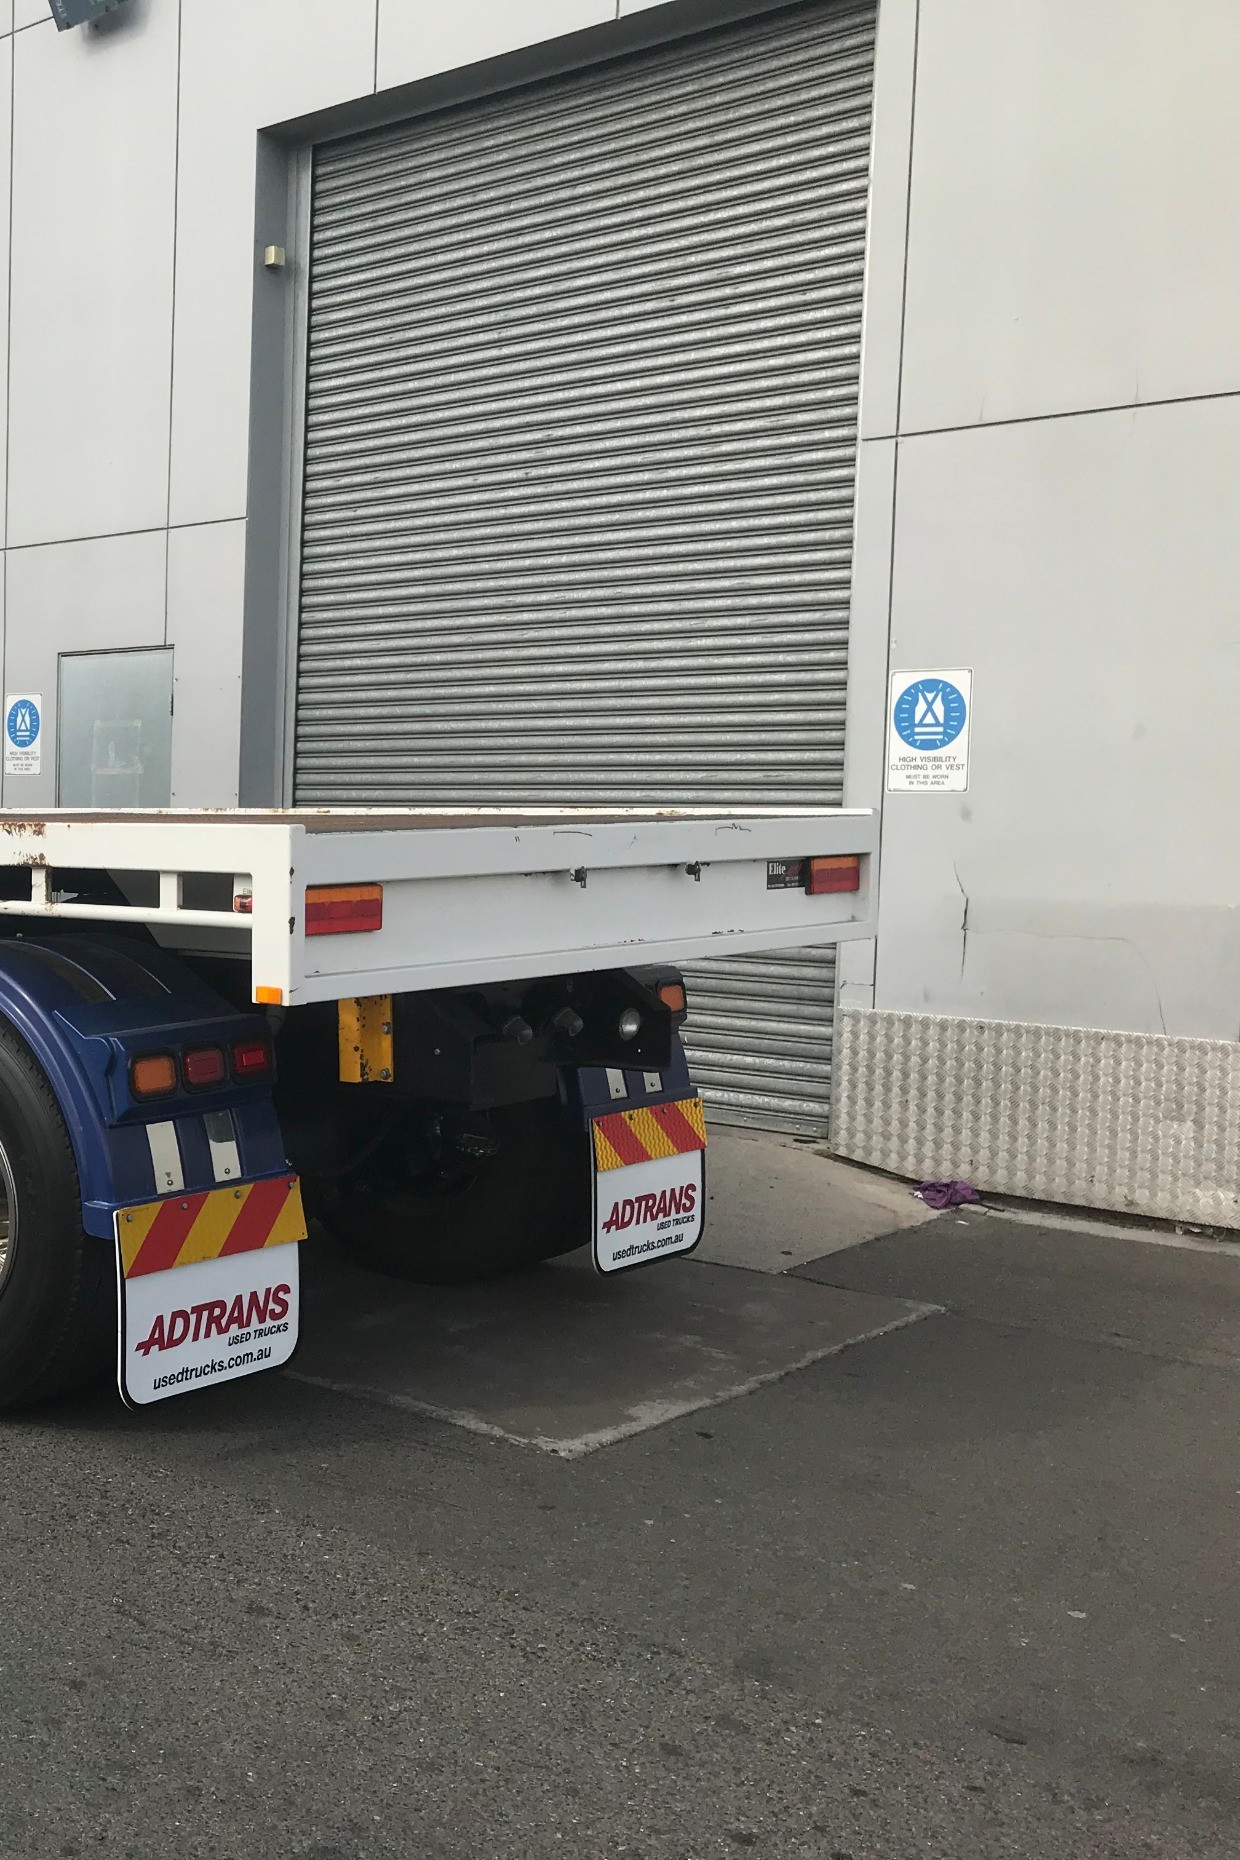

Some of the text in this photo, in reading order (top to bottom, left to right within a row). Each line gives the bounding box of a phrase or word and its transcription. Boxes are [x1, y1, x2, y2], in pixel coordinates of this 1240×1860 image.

[920, 755, 957, 763] VISIBILITY
[945, 763, 966, 771] VEST
[768, 862, 786, 875] Elite
[601, 1183, 697, 1234] ADTRANS
[656, 1214, 695, 1231] USED TRUCKS
[612, 1233, 684, 1261] usedtrucks.com.au
[134, 1283, 291, 1357] ADTRANS
[228, 1322, 289, 1347] USED TRUCKS
[153, 1346, 272, 1390] usedtrucks.com.au
